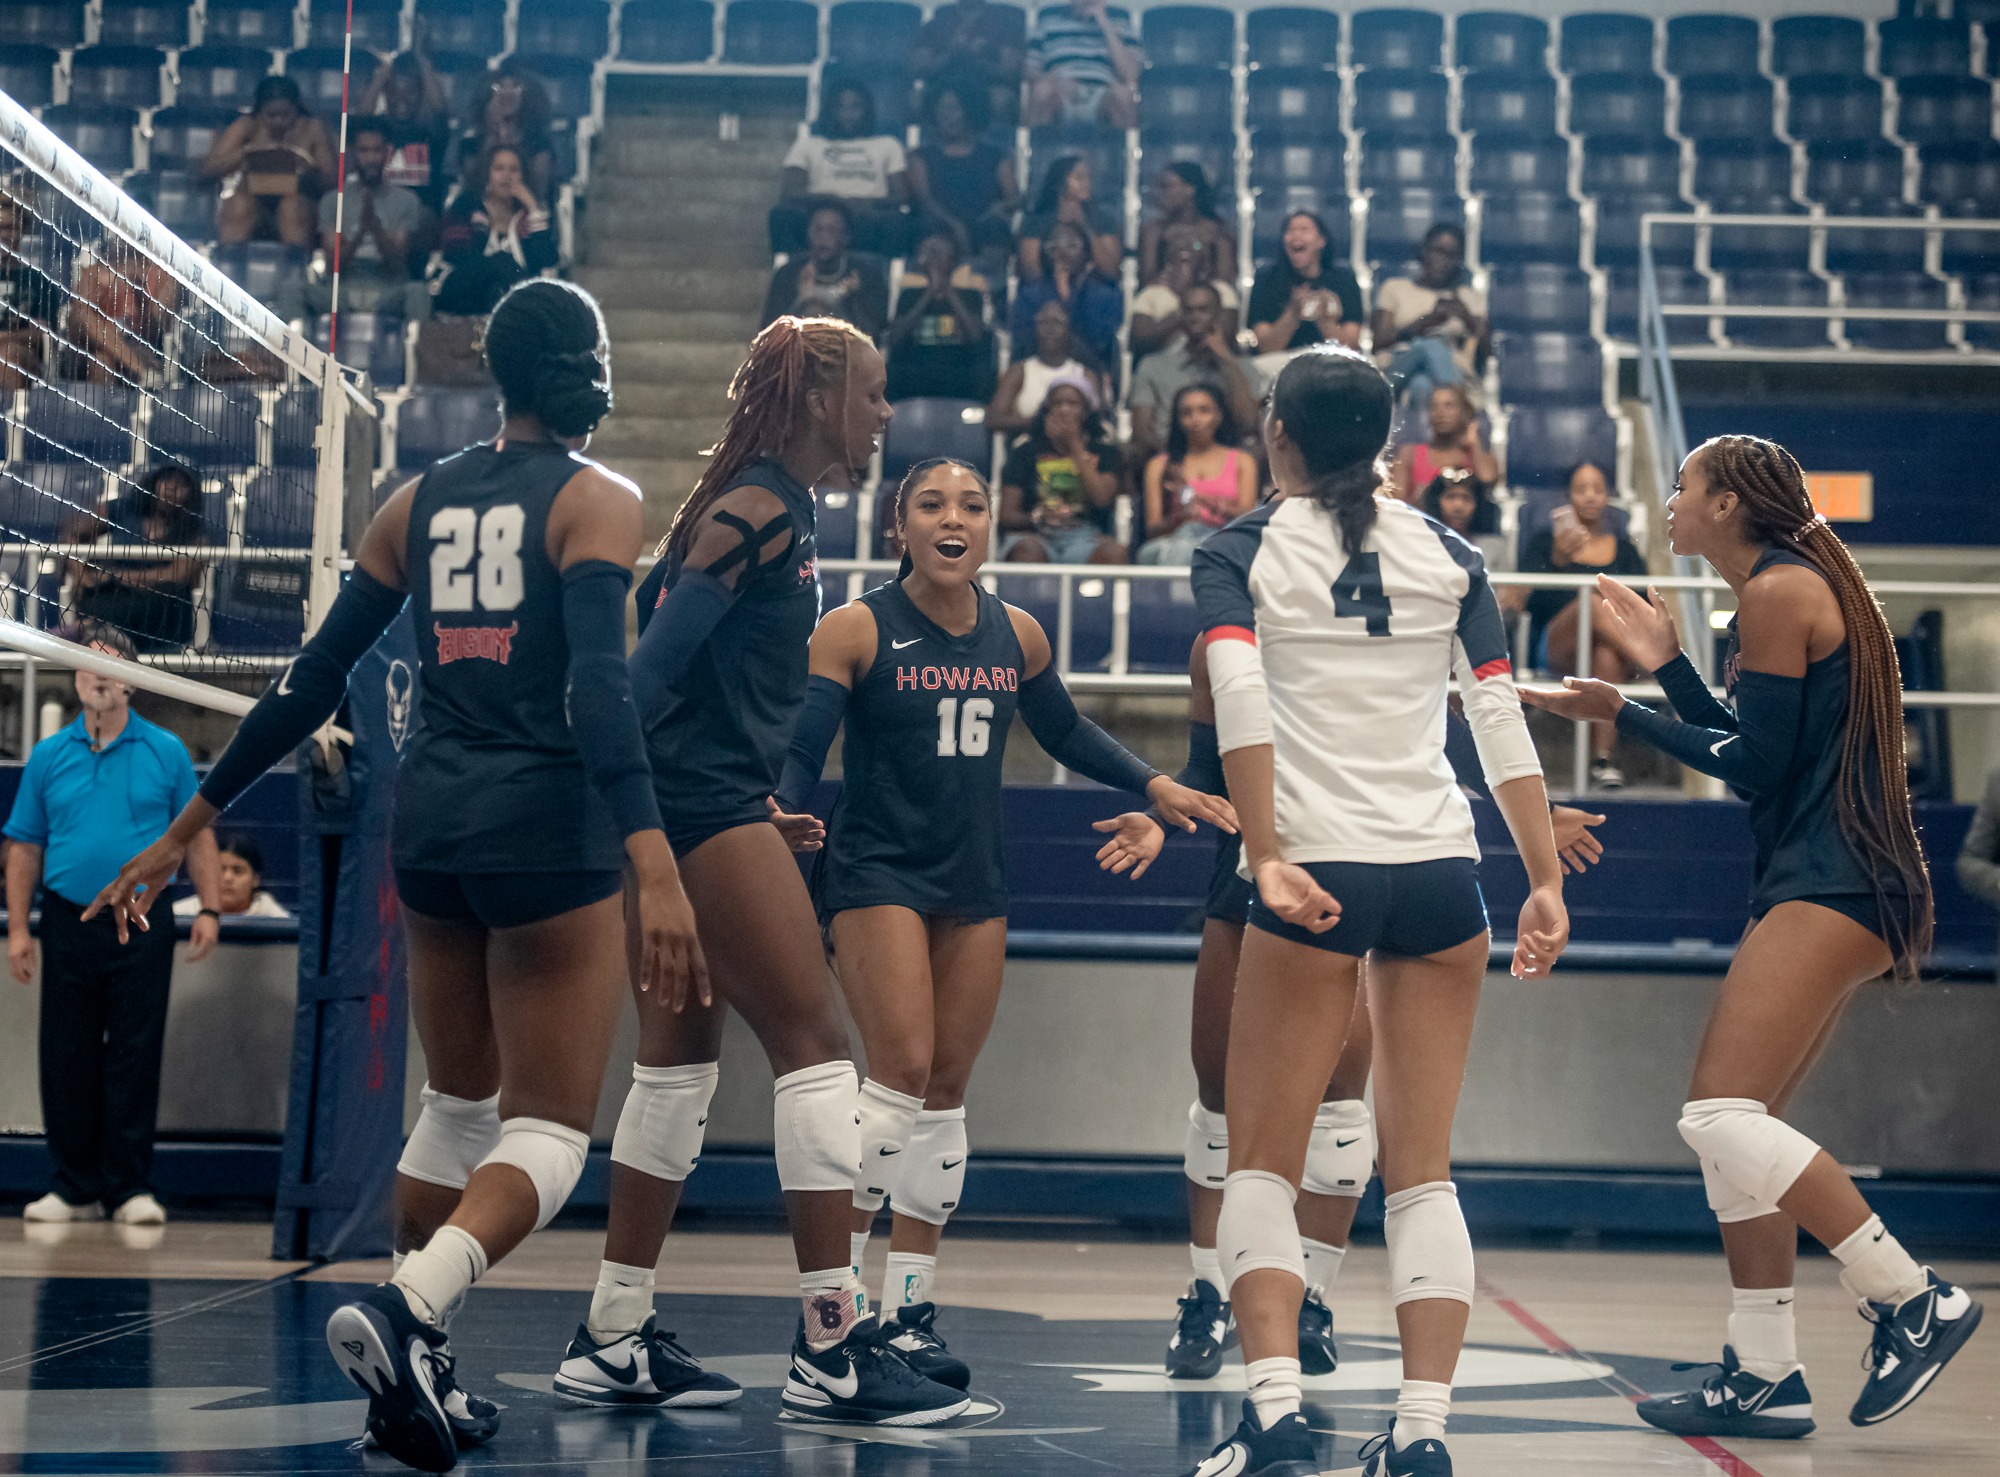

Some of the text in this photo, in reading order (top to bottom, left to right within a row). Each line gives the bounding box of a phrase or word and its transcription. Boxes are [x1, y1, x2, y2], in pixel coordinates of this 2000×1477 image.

[428, 504, 526, 612] 28
[1330, 551, 1393, 637] 4
[433, 620, 518, 666] BISON
[896, 666, 1018, 692] HOWARD
[937, 697, 995, 757] 16
